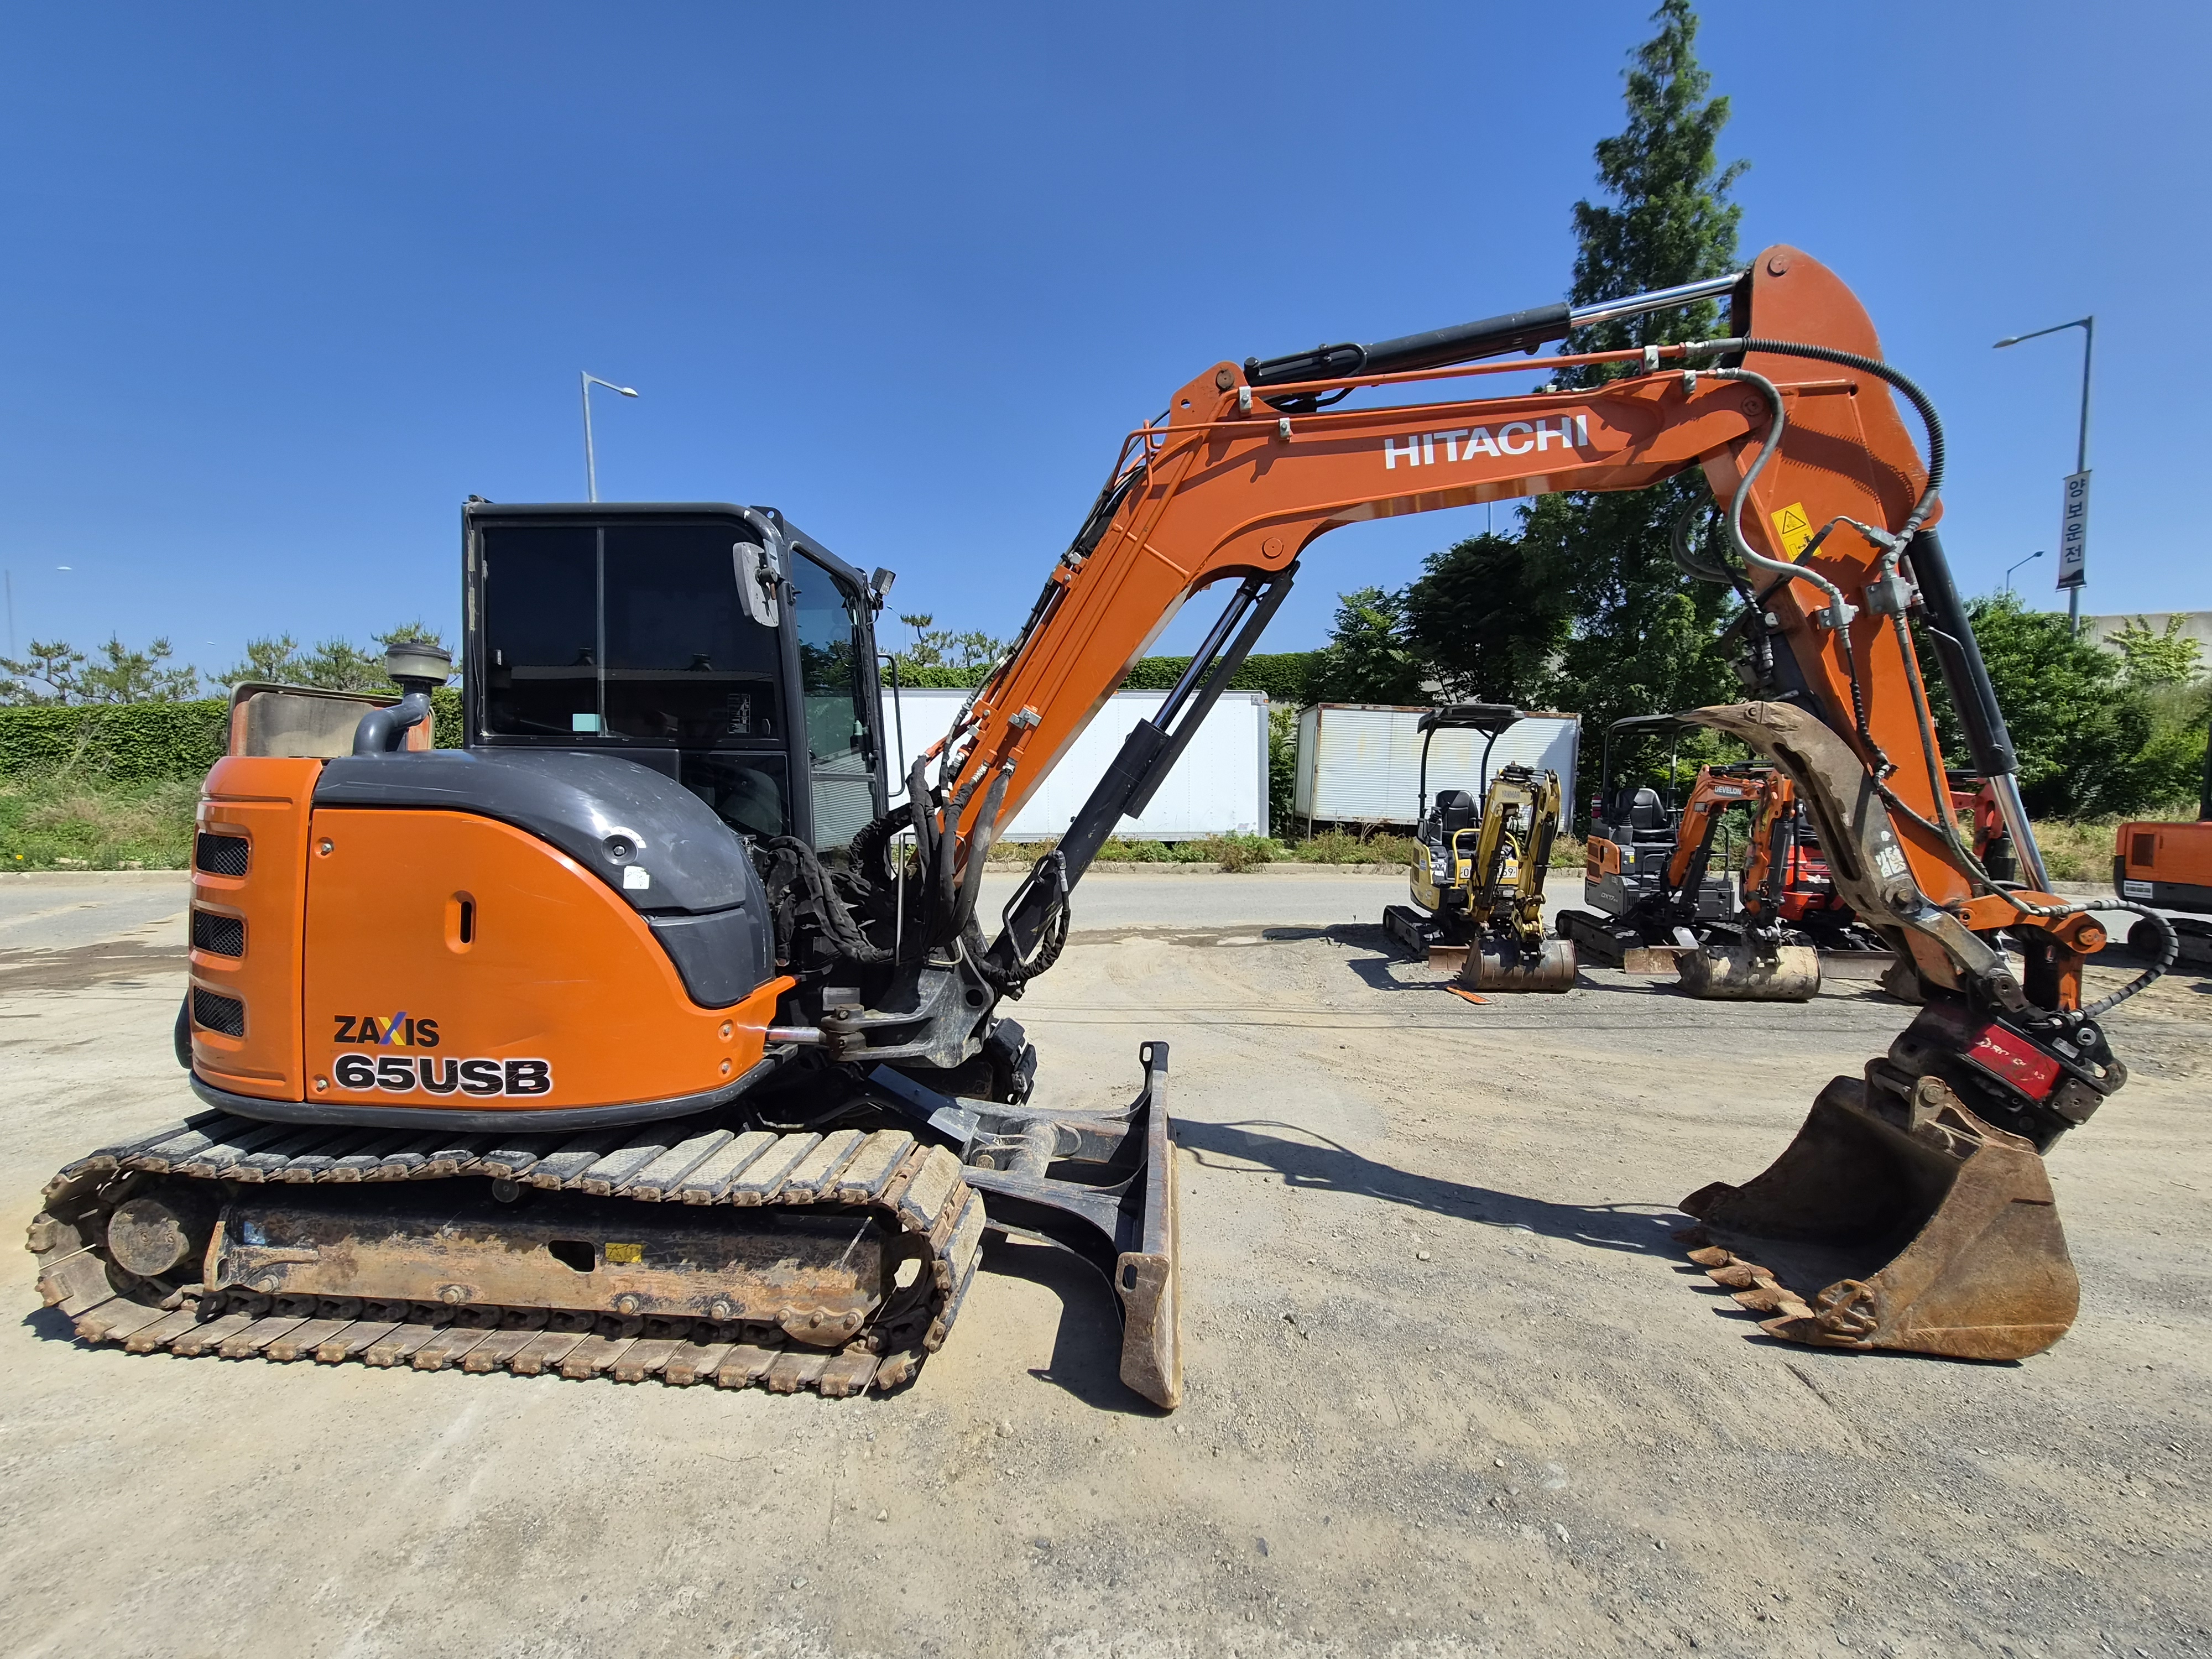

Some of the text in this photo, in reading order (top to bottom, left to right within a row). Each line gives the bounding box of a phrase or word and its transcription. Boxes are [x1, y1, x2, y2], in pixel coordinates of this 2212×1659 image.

[1384, 414, 1588, 469] HITACHI
[2065, 478, 2086, 564] 양보운전
[1714, 786, 1742, 795] DEVELON
[334, 1011, 440, 1047] ZAXIS
[334, 1053, 552, 1096] 65USB
